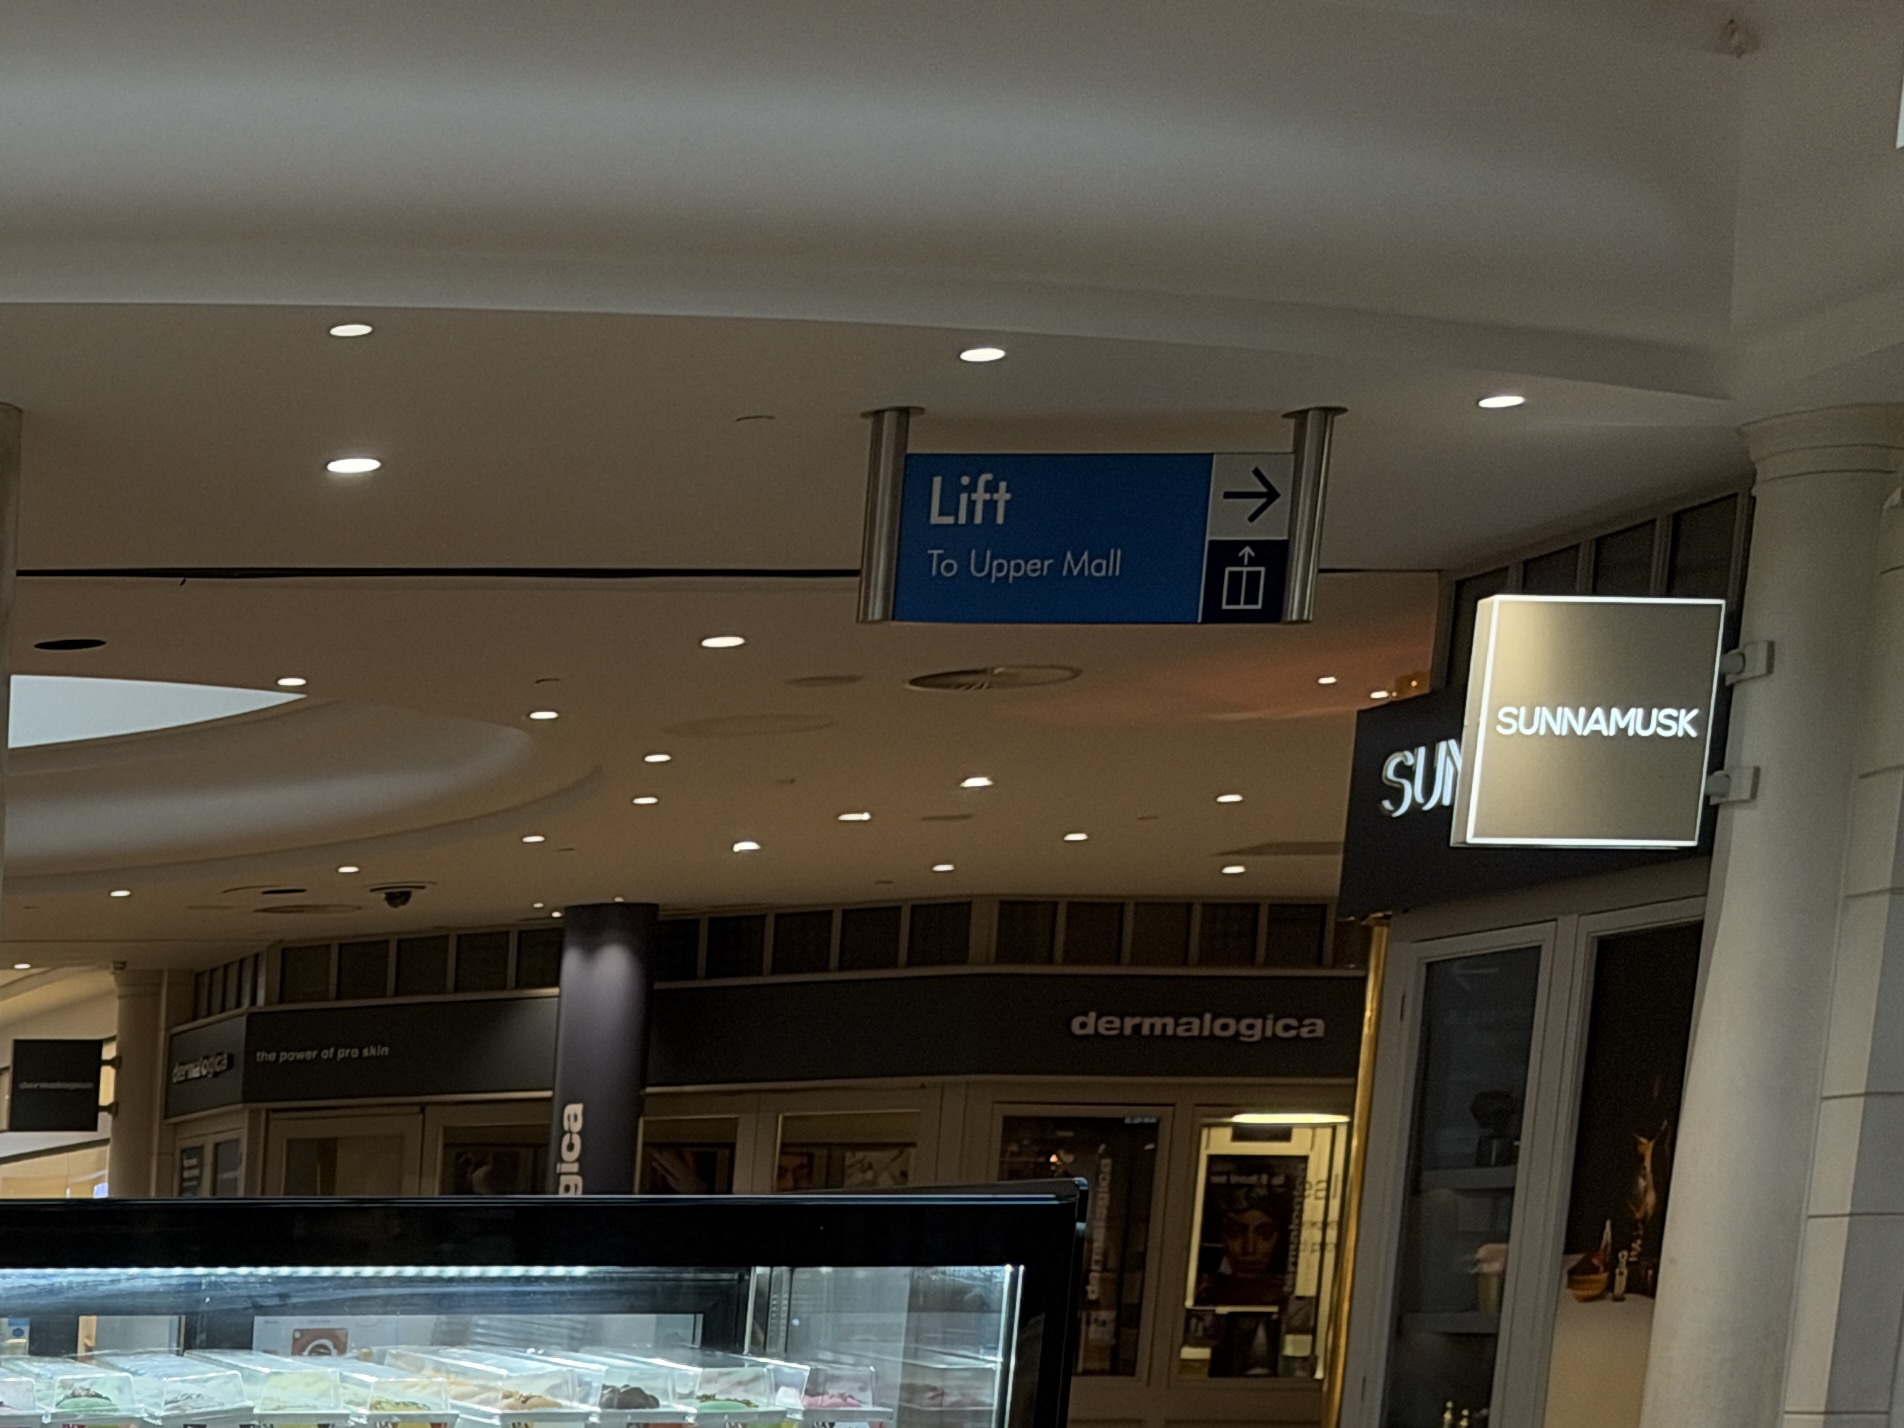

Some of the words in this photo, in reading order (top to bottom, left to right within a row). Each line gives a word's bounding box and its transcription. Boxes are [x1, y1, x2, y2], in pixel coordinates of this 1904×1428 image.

[930, 473, 1012, 525] Lift
[928, 549, 958, 577] To
[970, 549, 1055, 584] Upper
[1062, 548, 1122, 577] Mall
[1495, 706, 1699, 738] SUNNAMUSK
[1069, 1011, 1326, 1042] dermalogica
[171, 1052, 228, 1084] dermalogica
[255, 1050, 276, 1062] the
[279, 1049, 318, 1064] power
[320, 1046, 336, 1060] of
[362, 1044, 390, 1058] skin
